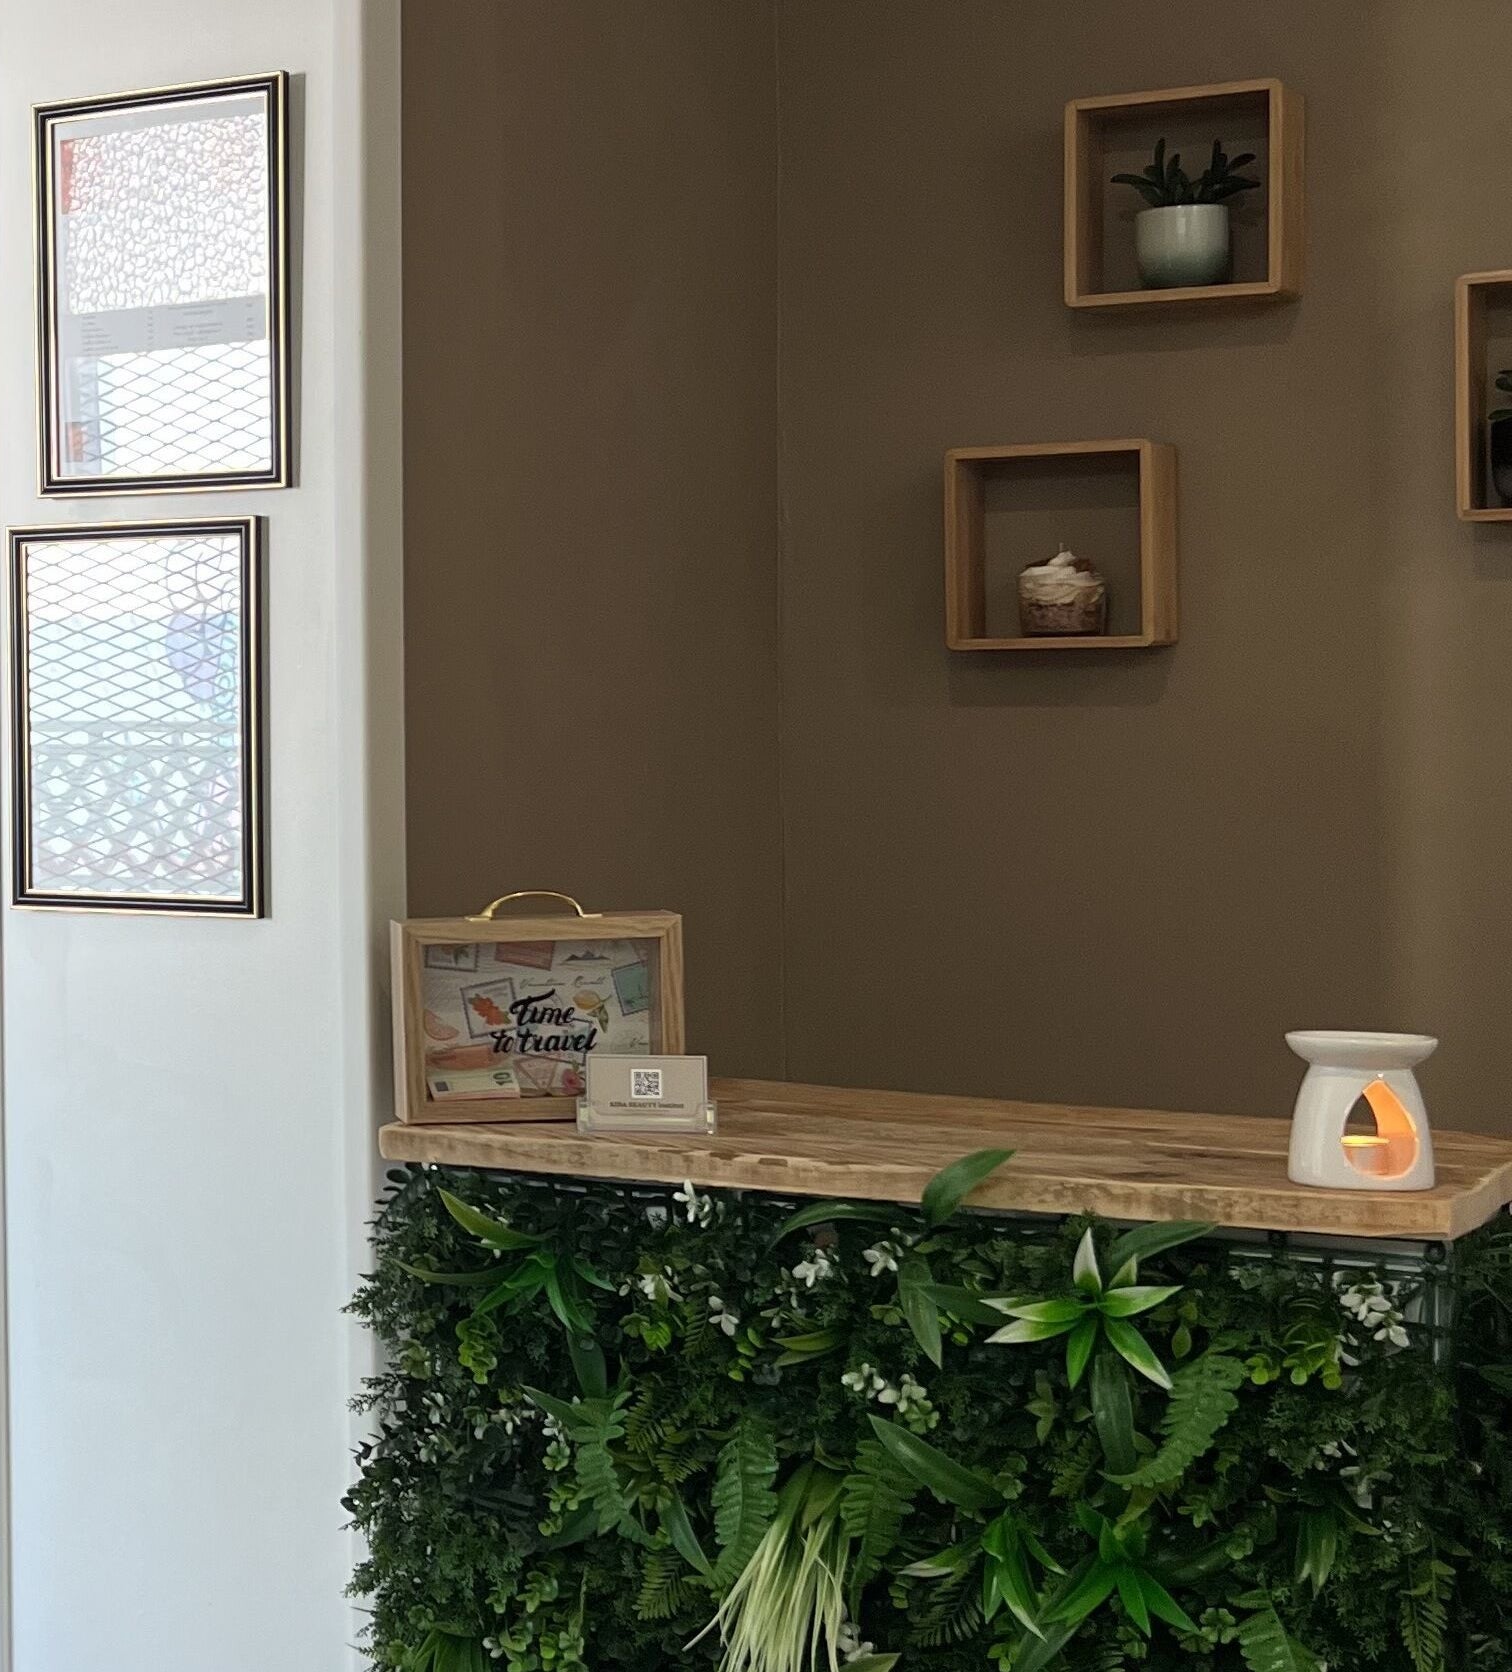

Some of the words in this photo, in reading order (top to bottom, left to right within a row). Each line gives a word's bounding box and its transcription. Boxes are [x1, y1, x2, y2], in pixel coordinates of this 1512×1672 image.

[509, 988, 576, 1026] Time
[490, 1031, 514, 1054] to
[516, 1028, 597, 1053] travel
